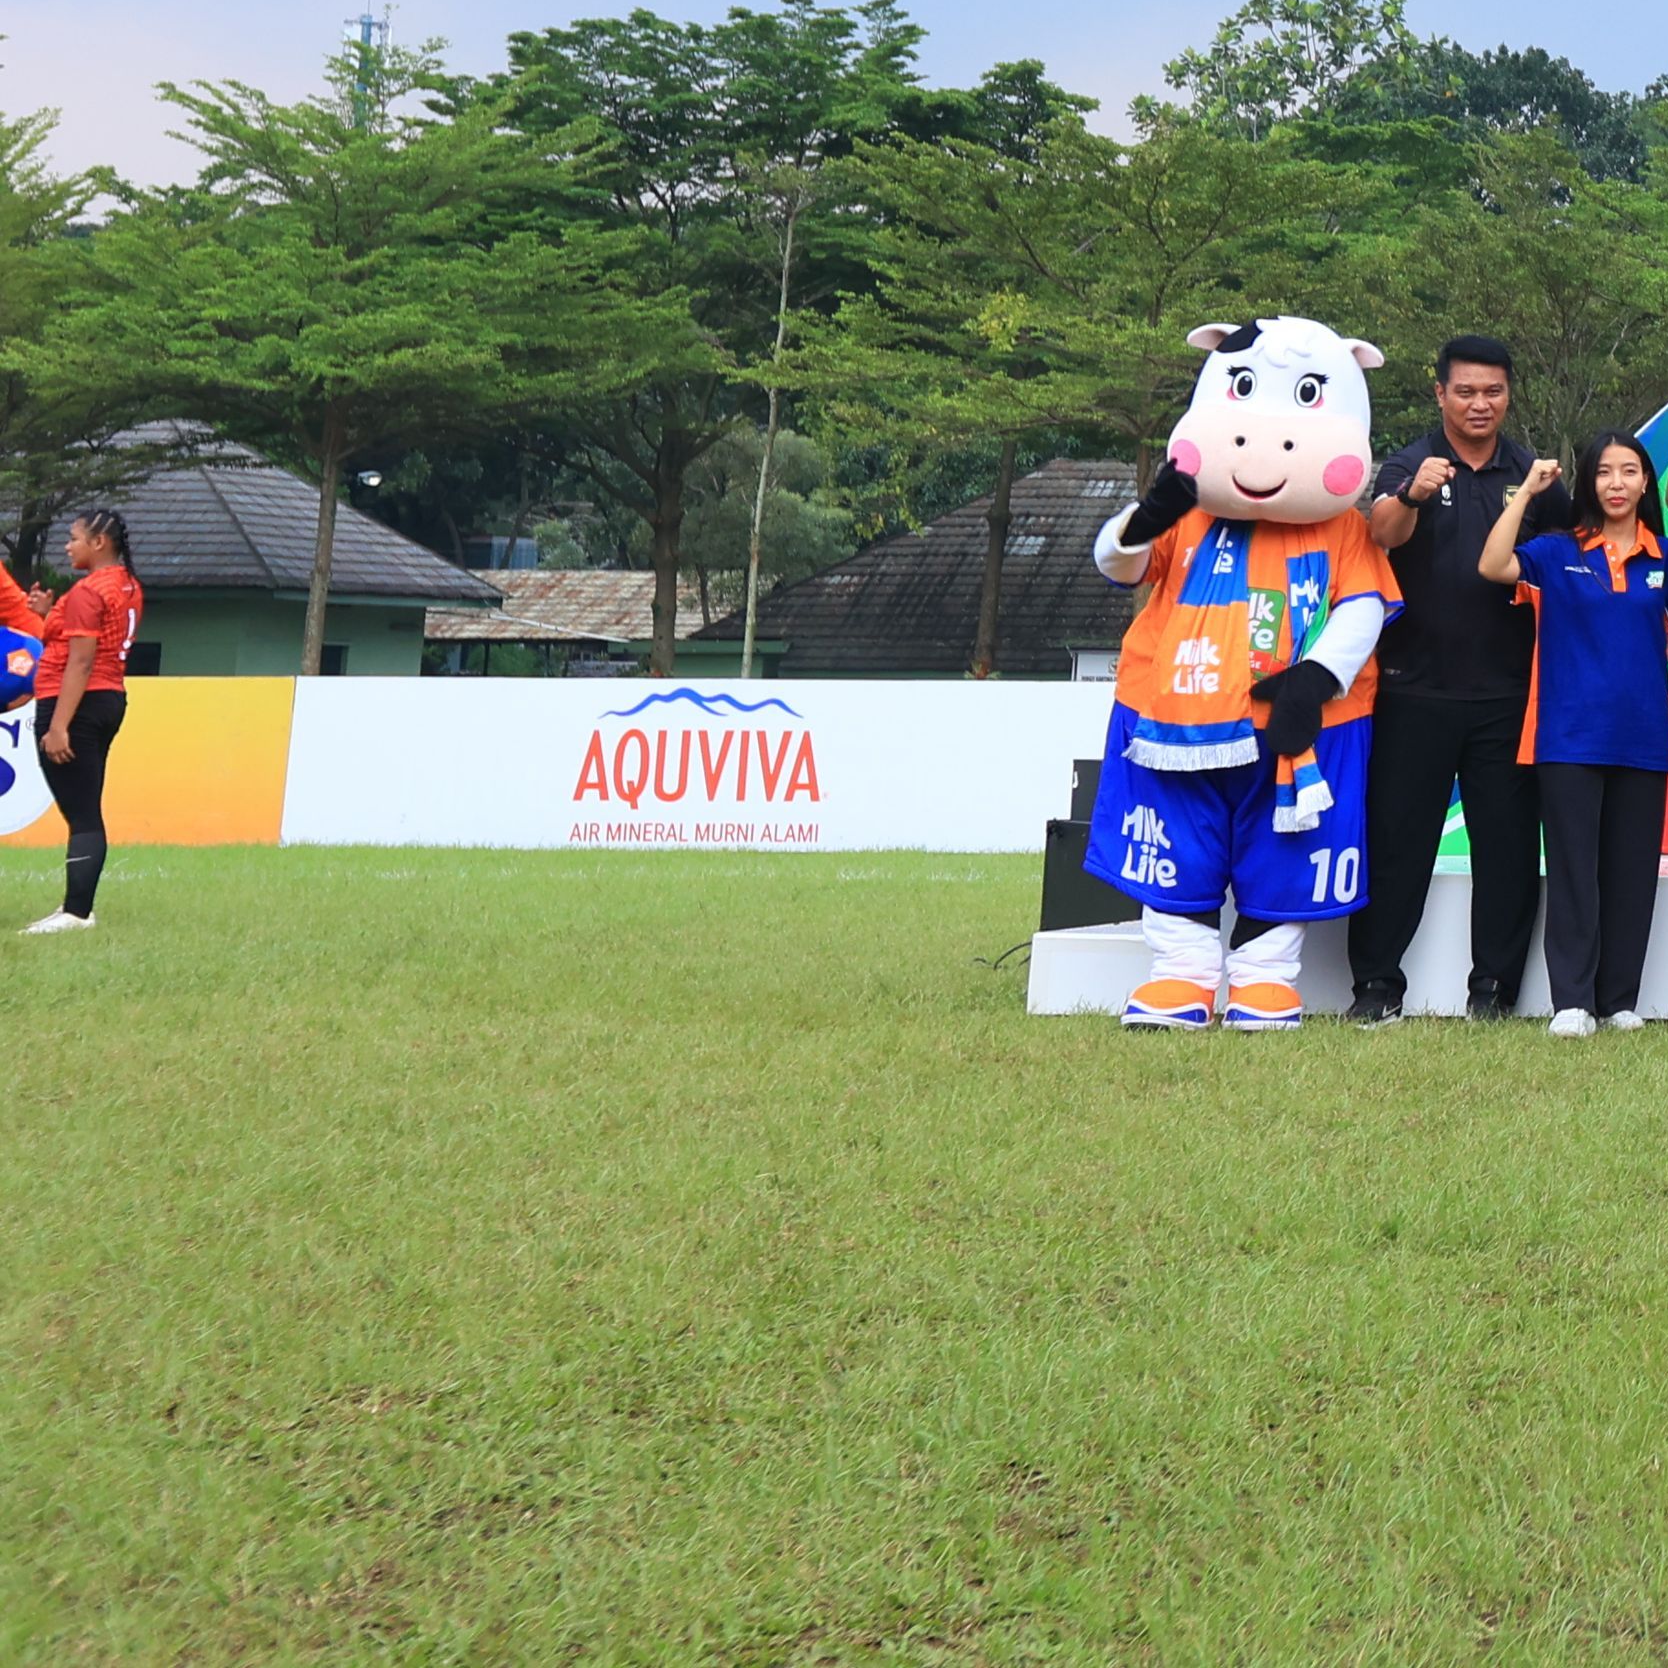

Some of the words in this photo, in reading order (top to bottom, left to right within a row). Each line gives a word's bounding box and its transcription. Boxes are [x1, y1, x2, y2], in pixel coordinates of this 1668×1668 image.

[1172, 665, 1220, 694] Life
[573, 729, 820, 810] AQUVIVA
[569, 823, 600, 842] AIR
[606, 823, 688, 842] MINERAL
[695, 823, 754, 842] MURNI
[760, 824, 819, 843] ALAMI
[1309, 847, 1360, 903] 10
